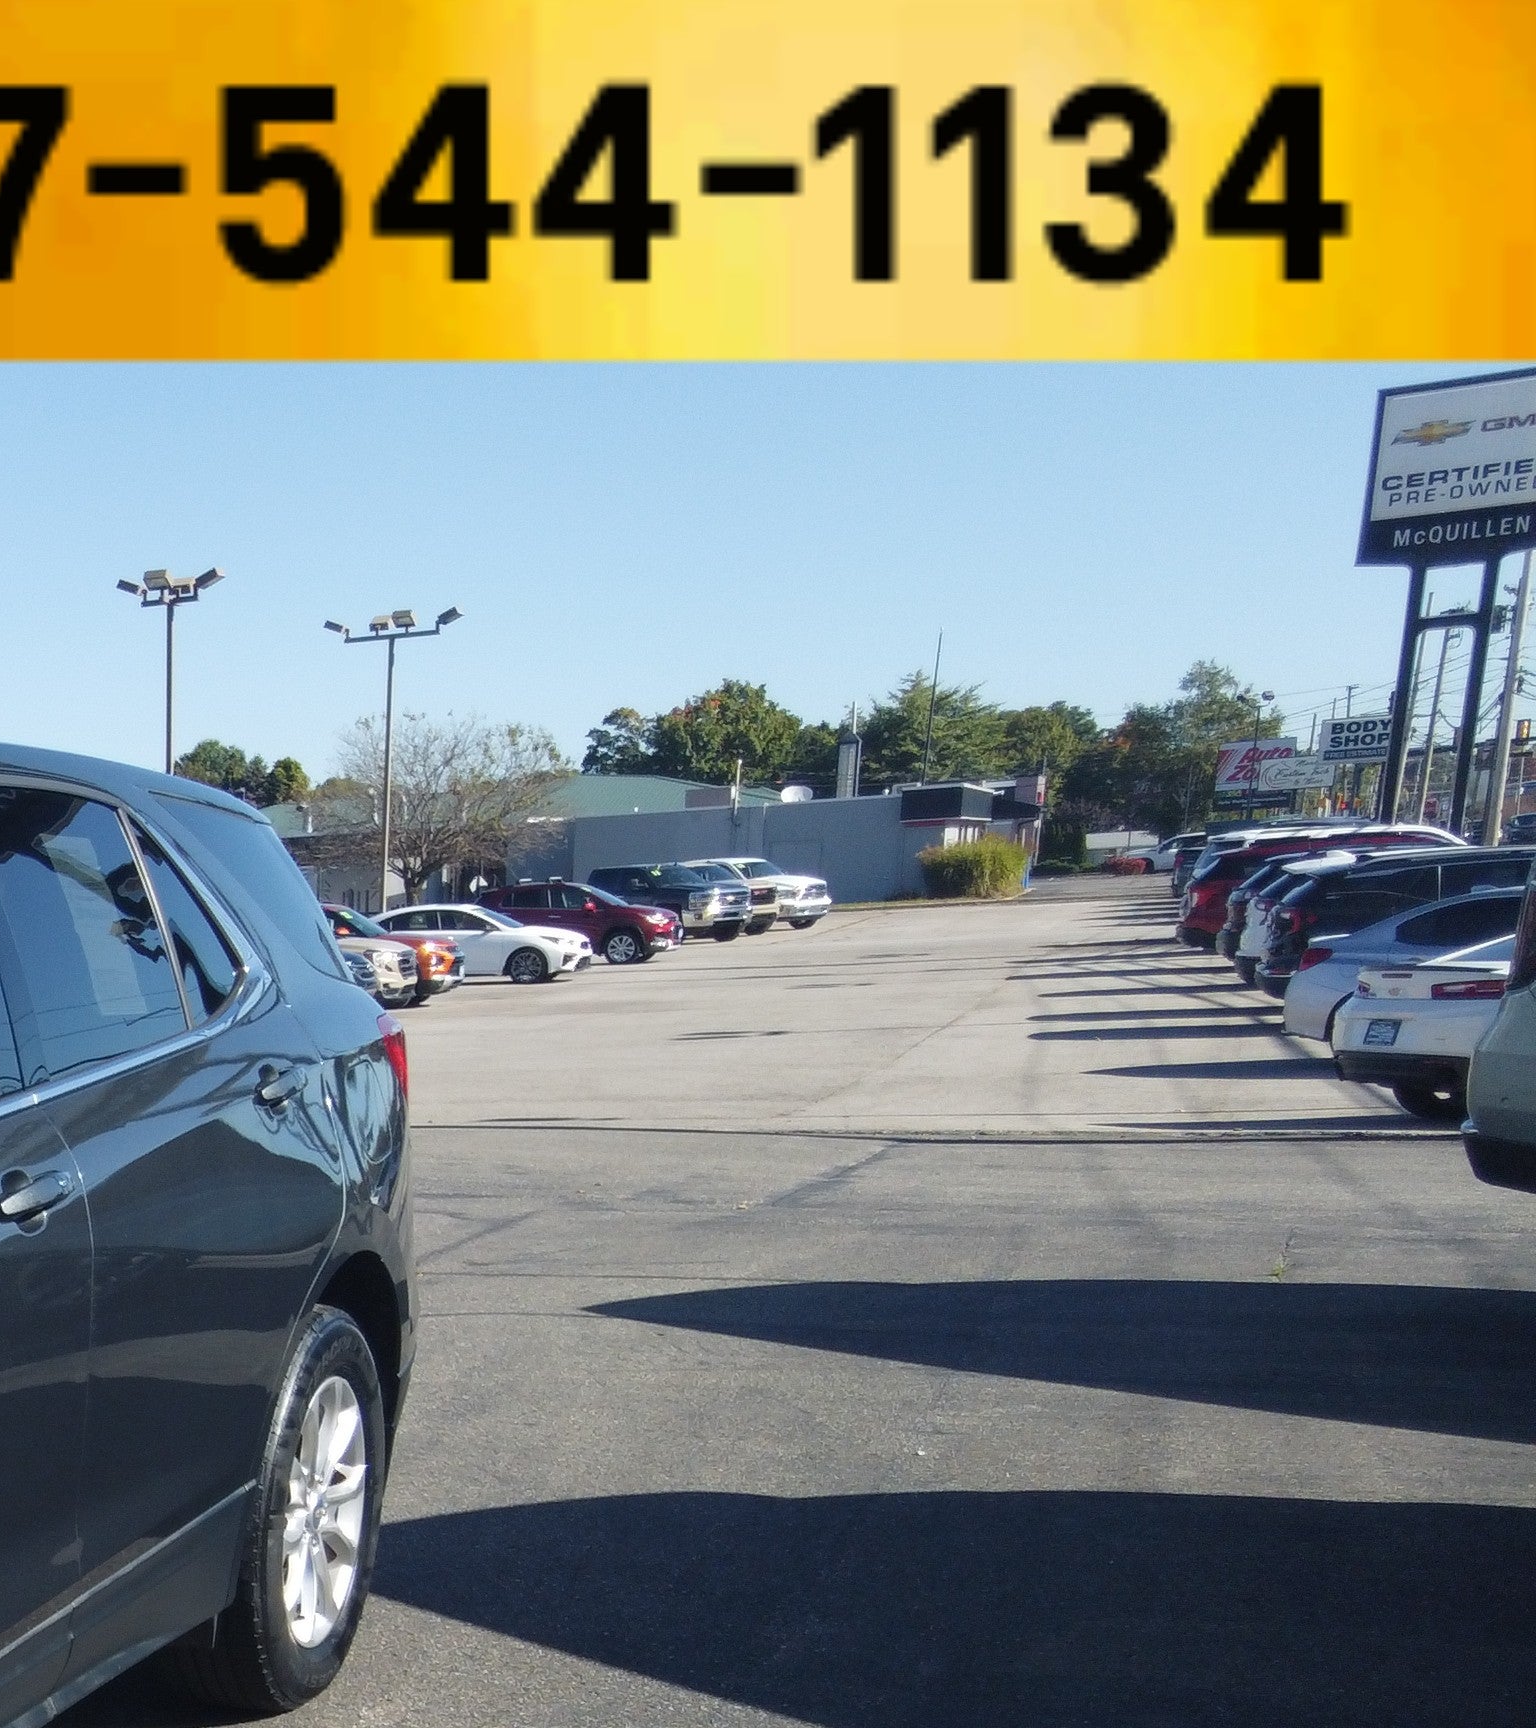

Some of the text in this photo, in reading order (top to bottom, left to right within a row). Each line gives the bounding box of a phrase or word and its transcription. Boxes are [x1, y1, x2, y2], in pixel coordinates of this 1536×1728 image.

[1481, 413, 1536, 433] GM
[1381, 458, 1535, 491] CERTIFIE
[1393, 515, 1531, 548] McQUILLEN
[1330, 719, 1392, 735] BODY
[1227, 764, 1260, 782] Zo
